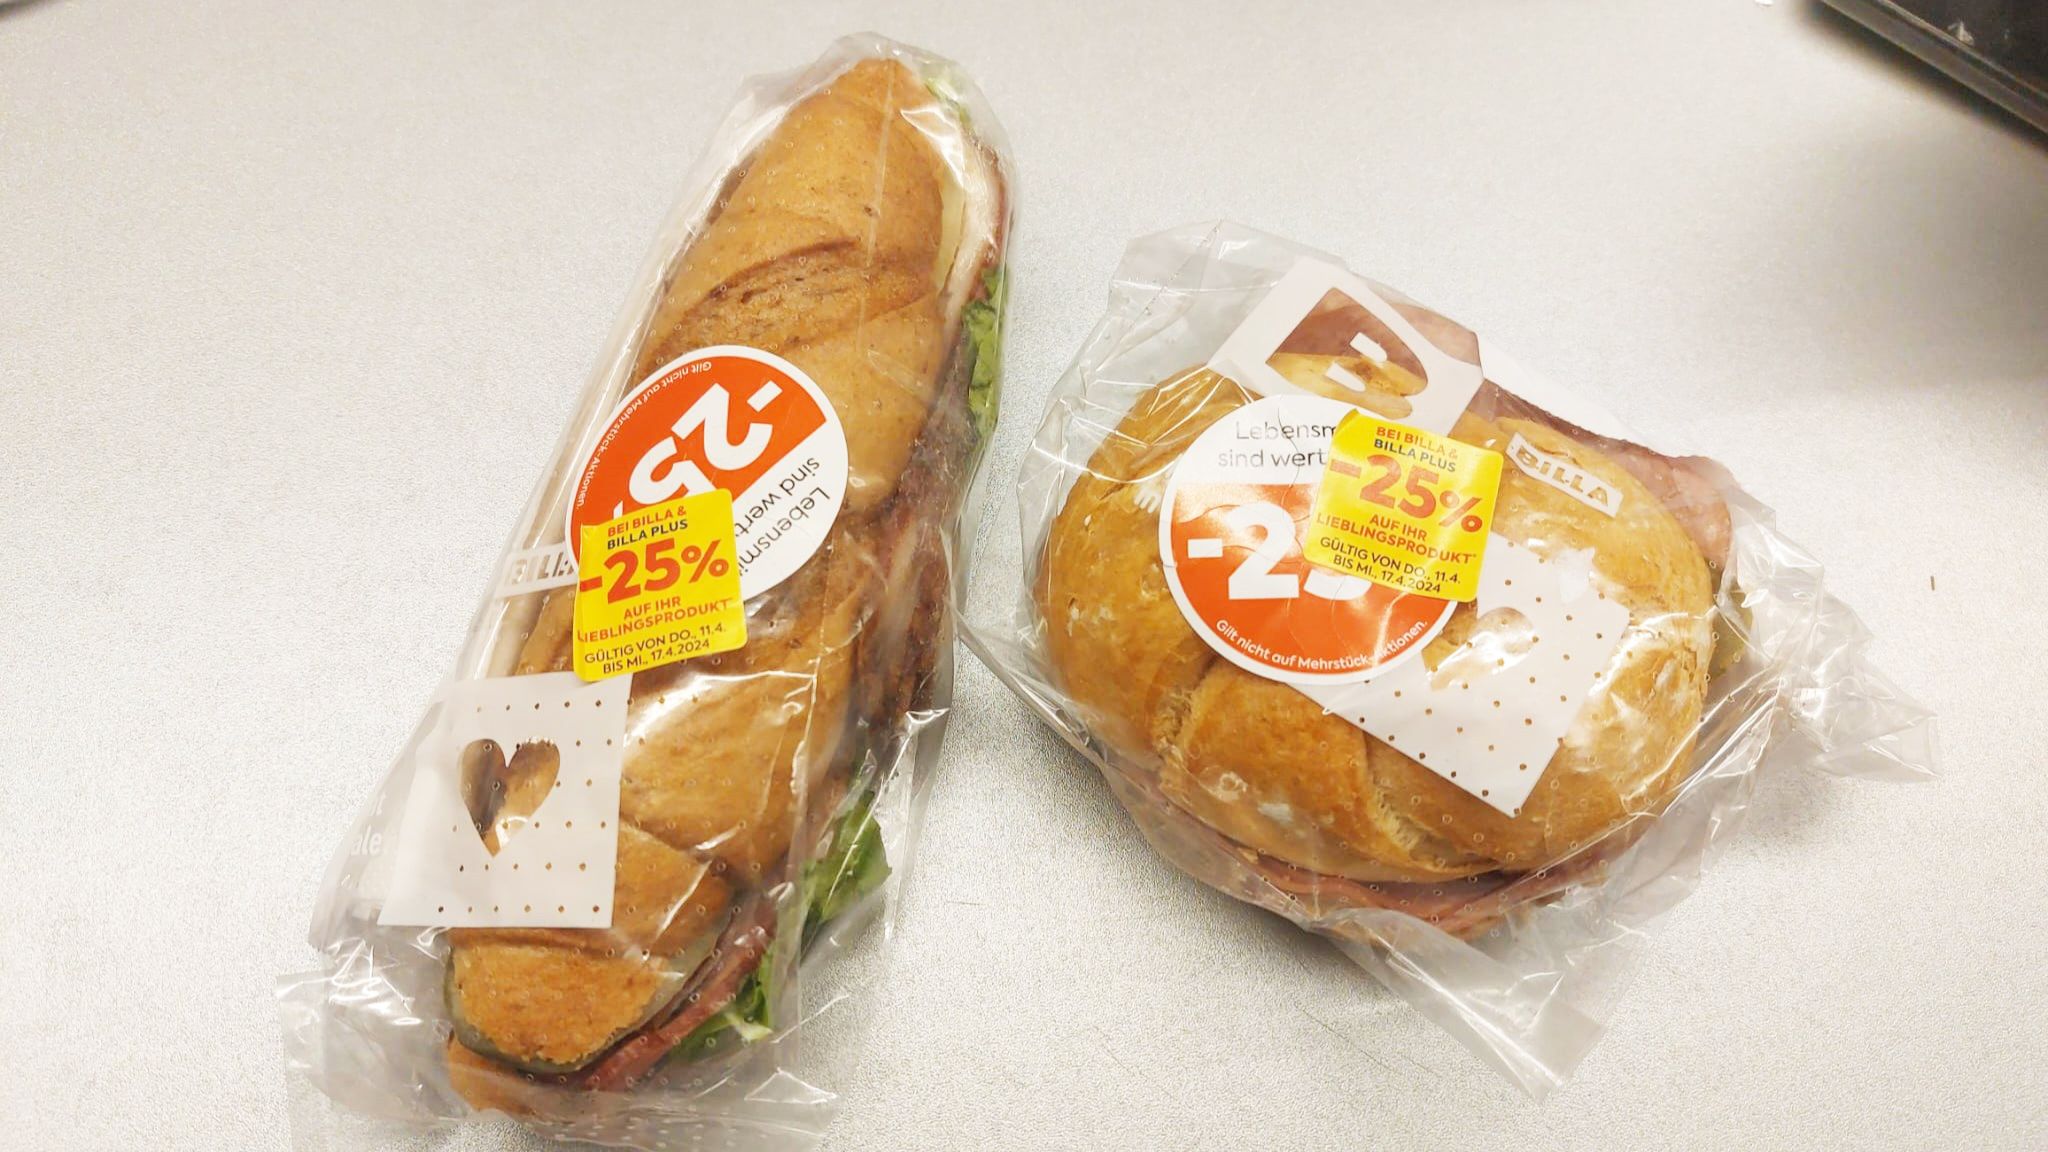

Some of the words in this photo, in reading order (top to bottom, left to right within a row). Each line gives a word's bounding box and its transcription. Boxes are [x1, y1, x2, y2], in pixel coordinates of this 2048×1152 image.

[661, 368, 689, 389] nicht
[691, 361, 712, 374] Gilt
[643, 385, 661, 403] auf
[613, 381, 783, 518] -25
[1218, 448, 1264, 468] sind
[1374, 438, 1417, 459] BILLA
[1420, 451, 1456, 473] PLUS
[1376, 426, 1401, 441] BEI
[1404, 432, 1446, 454] BILLA
[1449, 448, 1459, 461] &
[778, 457, 821, 497] sind
[1329, 454, 1483, 533] -25%
[1516, 445, 1608, 507] BILLA
[607, 519, 630, 538] BEI
[632, 509, 674, 529] BILLA
[677, 505, 687, 517] &
[734, 493, 782, 537] wert
[737, 487, 830, 577] Lebensmi
[1369, 514, 1401, 530] AUF
[1402, 524, 1428, 542] IHR
[607, 529, 648, 551] BILLA
[651, 519, 689, 538] PLUS
[579, 537, 730, 604] -25%
[1320, 536, 1369, 561] GÜLTIG
[1371, 552, 1401, 571] VON
[1435, 571, 1461, 584] 11.4.
[1333, 555, 1354, 570] BIS
[1356, 563, 1377, 579] MI.,
[1381, 569, 1441, 594] 17.4.2024
[624, 603, 652, 620] AUF
[655, 596, 681, 612] IHR
[584, 644, 634, 664] GÜLTIG
[636, 635, 666, 652] VON
[700, 623, 726, 637] 11.4.
[603, 660, 623, 675] BIS
[626, 656, 649, 669] MI.,
[651, 638, 710, 660] 17.4.2024
[1216, 619, 1238, 643] Gilt
[1237, 636, 1271, 661] nicht
[1272, 653, 1299, 667] auf
